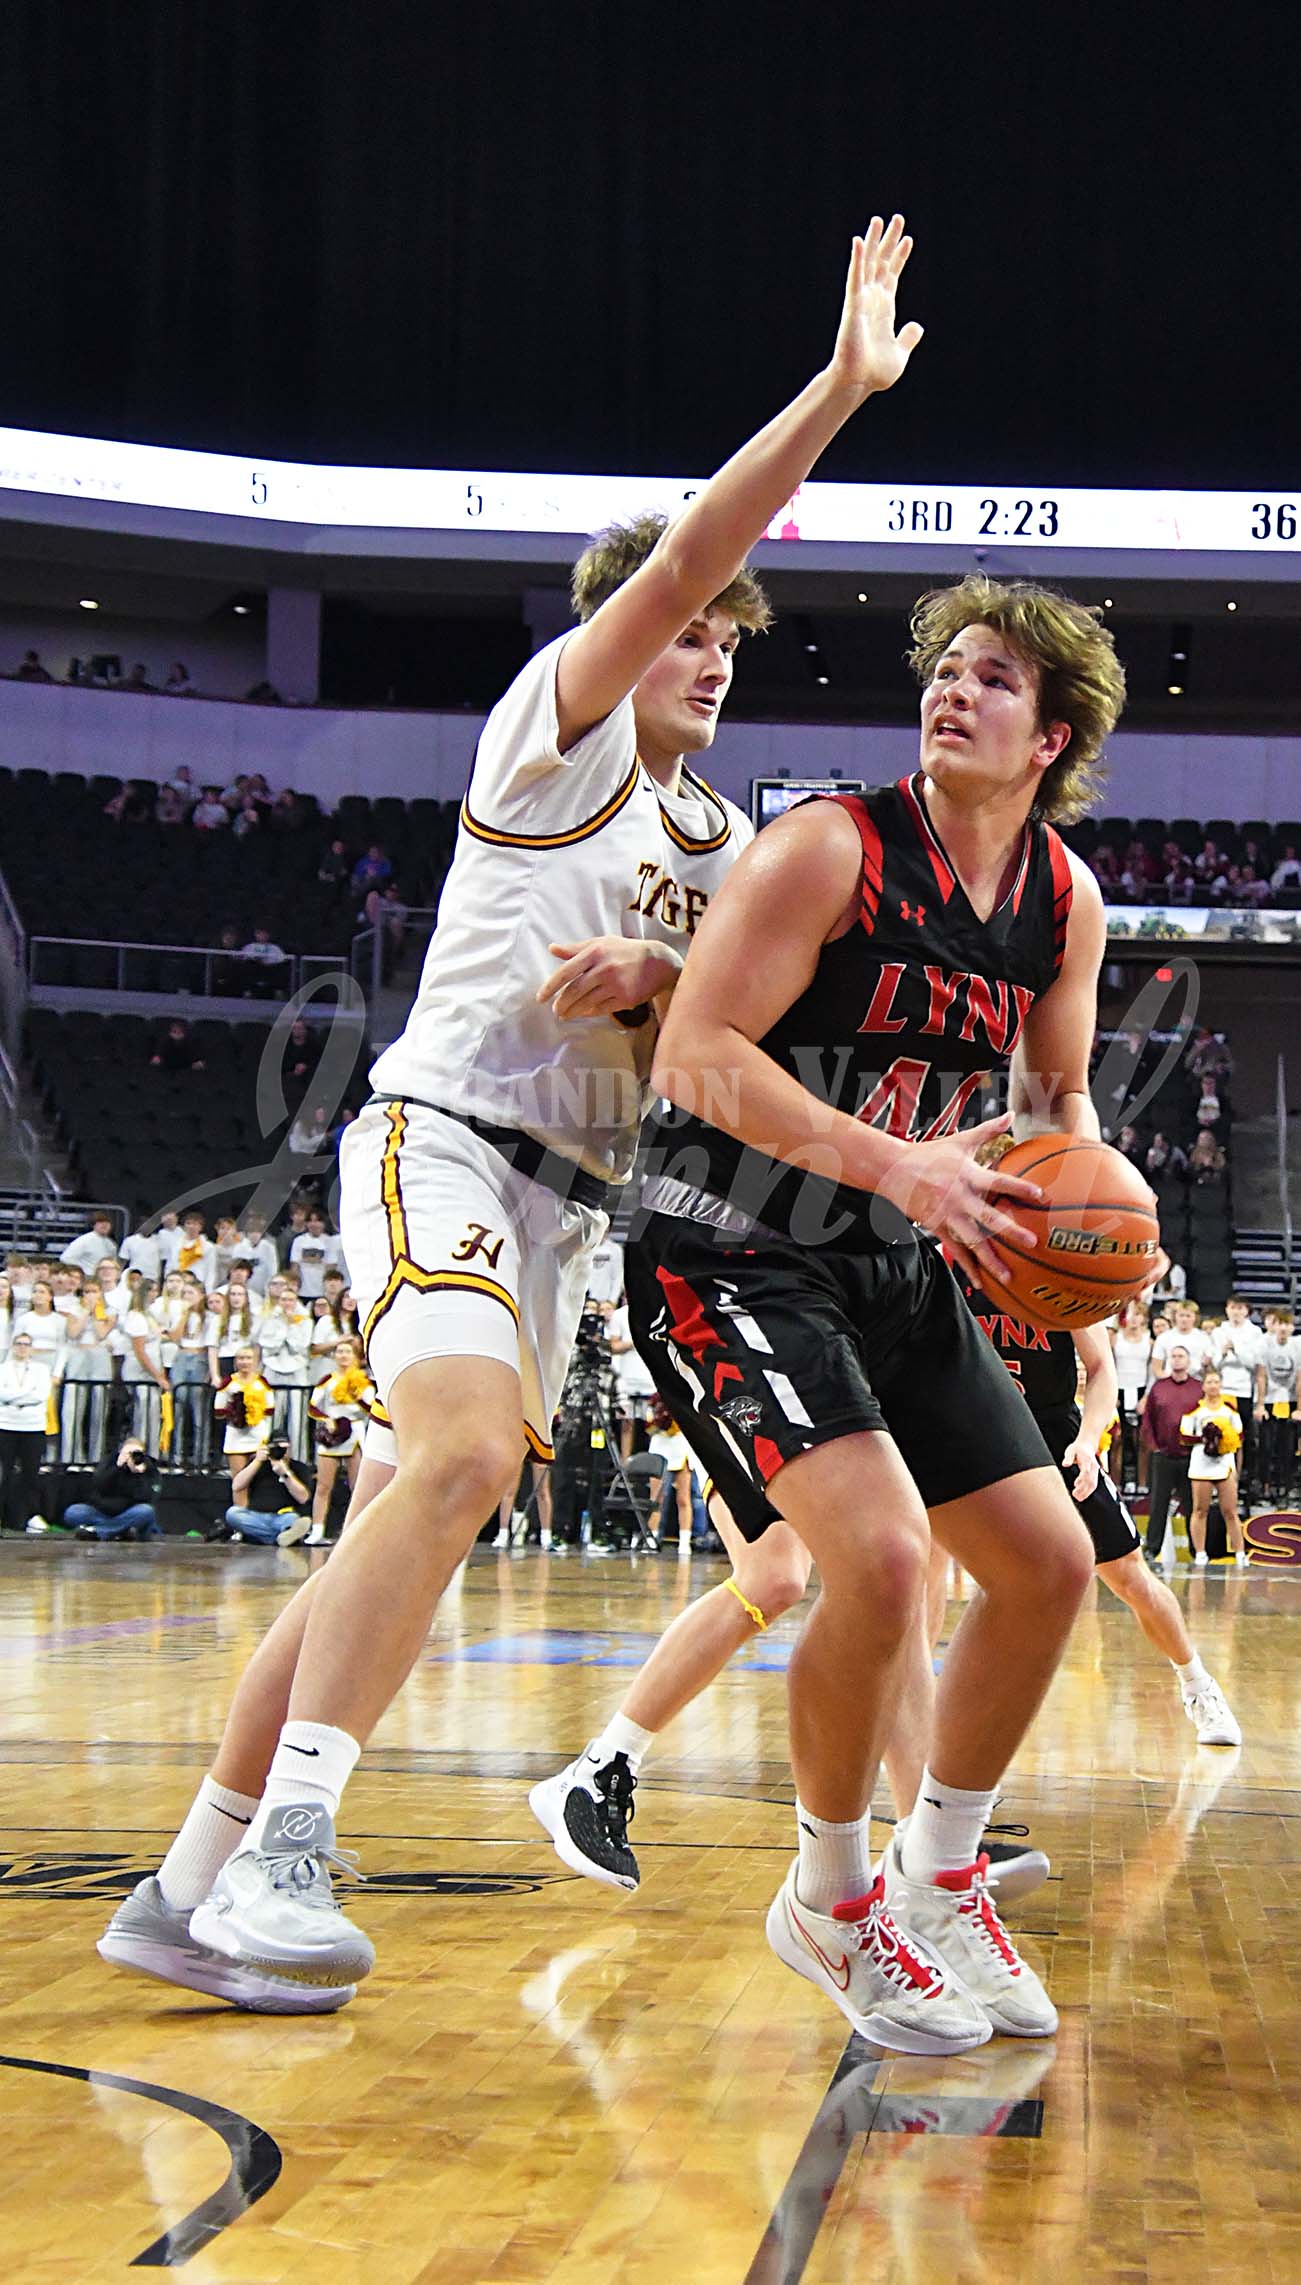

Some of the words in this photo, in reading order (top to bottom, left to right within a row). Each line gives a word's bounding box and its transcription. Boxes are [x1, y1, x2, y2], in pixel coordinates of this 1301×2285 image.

[251, 472, 268, 505] 5
[466, 485, 483, 517] 5
[888, 499, 953, 532] 3RD
[977, 499, 1059, 537] 2:23
[1251, 503, 1298, 540] 36
